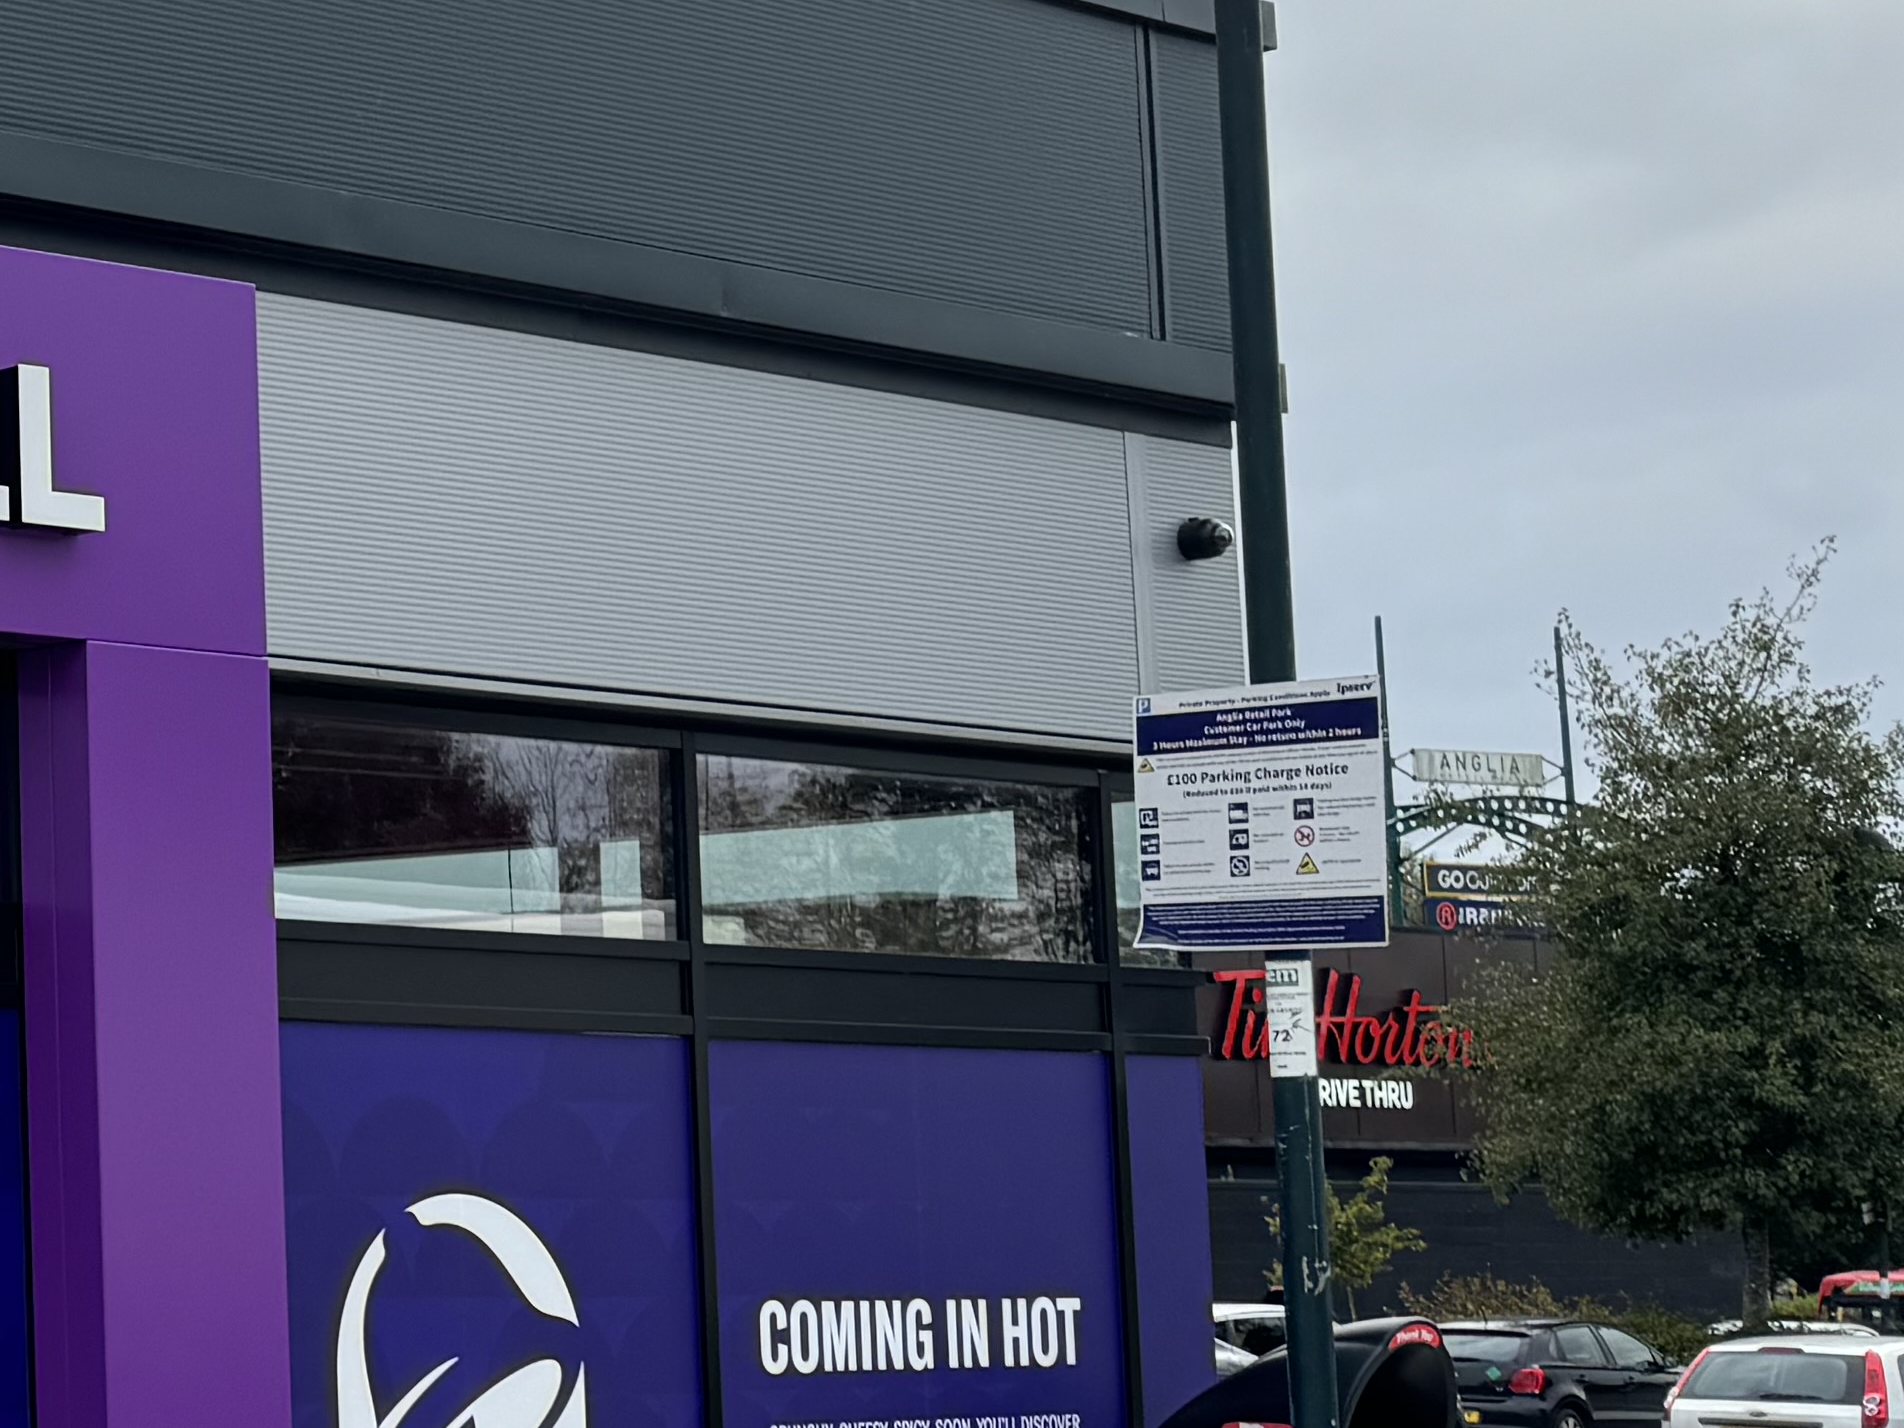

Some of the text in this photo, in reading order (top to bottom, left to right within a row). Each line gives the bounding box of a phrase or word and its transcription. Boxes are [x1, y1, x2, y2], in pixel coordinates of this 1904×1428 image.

[1216, 711, 1243, 723] Anglia
[1204, 724, 1244, 735] Customer
[1246, 721, 1261, 732] Car
[1167, 762, 1349, 786] £100 Parking Charge Notice
[1440, 754, 1521, 773] ANGLIA
[1437, 869, 1465, 890] GO
[1318, 1078, 1414, 1110] RIVE THRU
[759, 1296, 1081, 1375] COMING IN HOT
